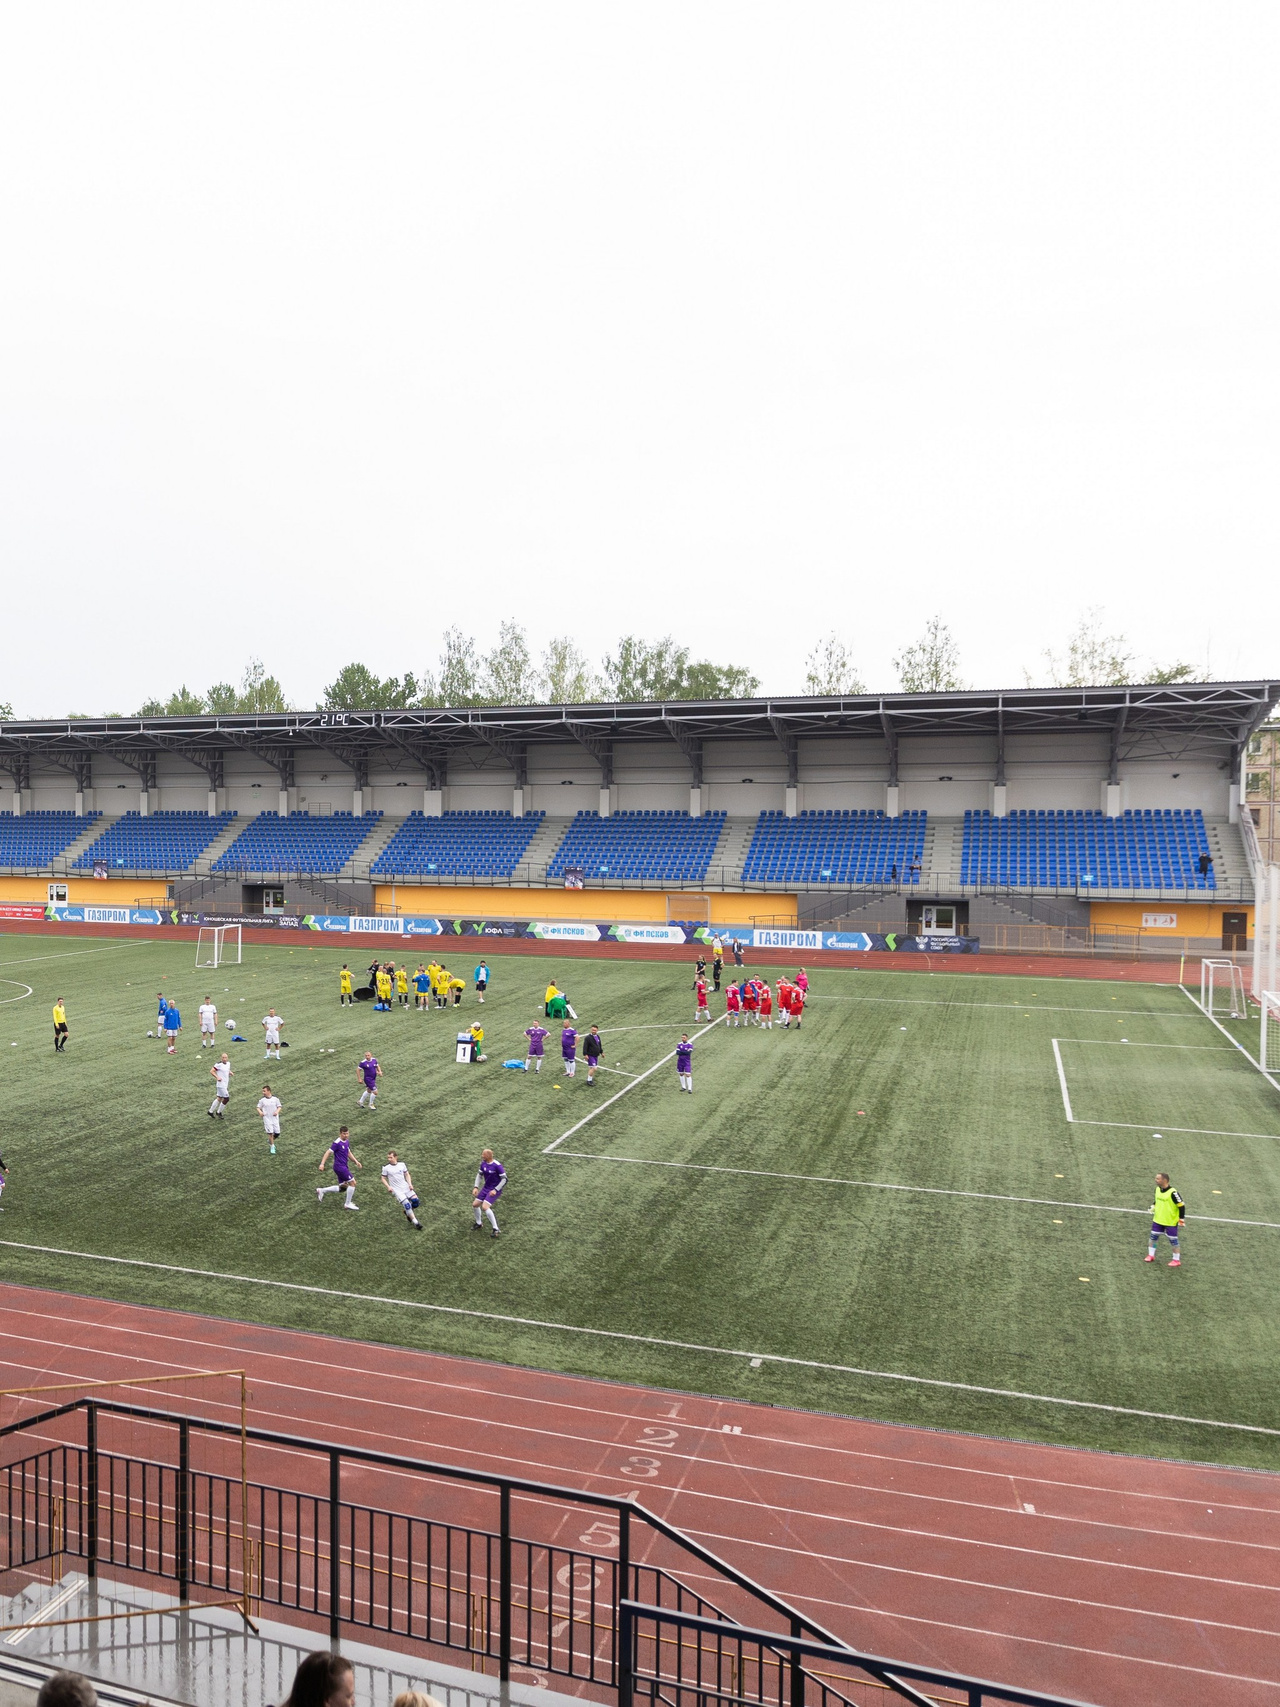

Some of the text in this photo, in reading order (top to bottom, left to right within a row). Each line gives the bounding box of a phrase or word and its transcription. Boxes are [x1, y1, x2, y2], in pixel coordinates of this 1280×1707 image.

[87, 910, 128, 922] ГАЗПРОМ
[353, 918, 400, 932] ГАЗПРОМ
[562, 928, 585, 936] ПСКОВ
[758, 931, 817, 947] ГАЗПРОМ
[462, 1046, 467, 1057] 1
[656, 1401, 687, 1420] 1
[635, 1426, 679, 1448] 2
[620, 1456, 662, 1478] 3
[579, 1521, 621, 1548] 5
[556, 1562, 605, 1591] 6
[543, 1604, 590, 1638] 7
